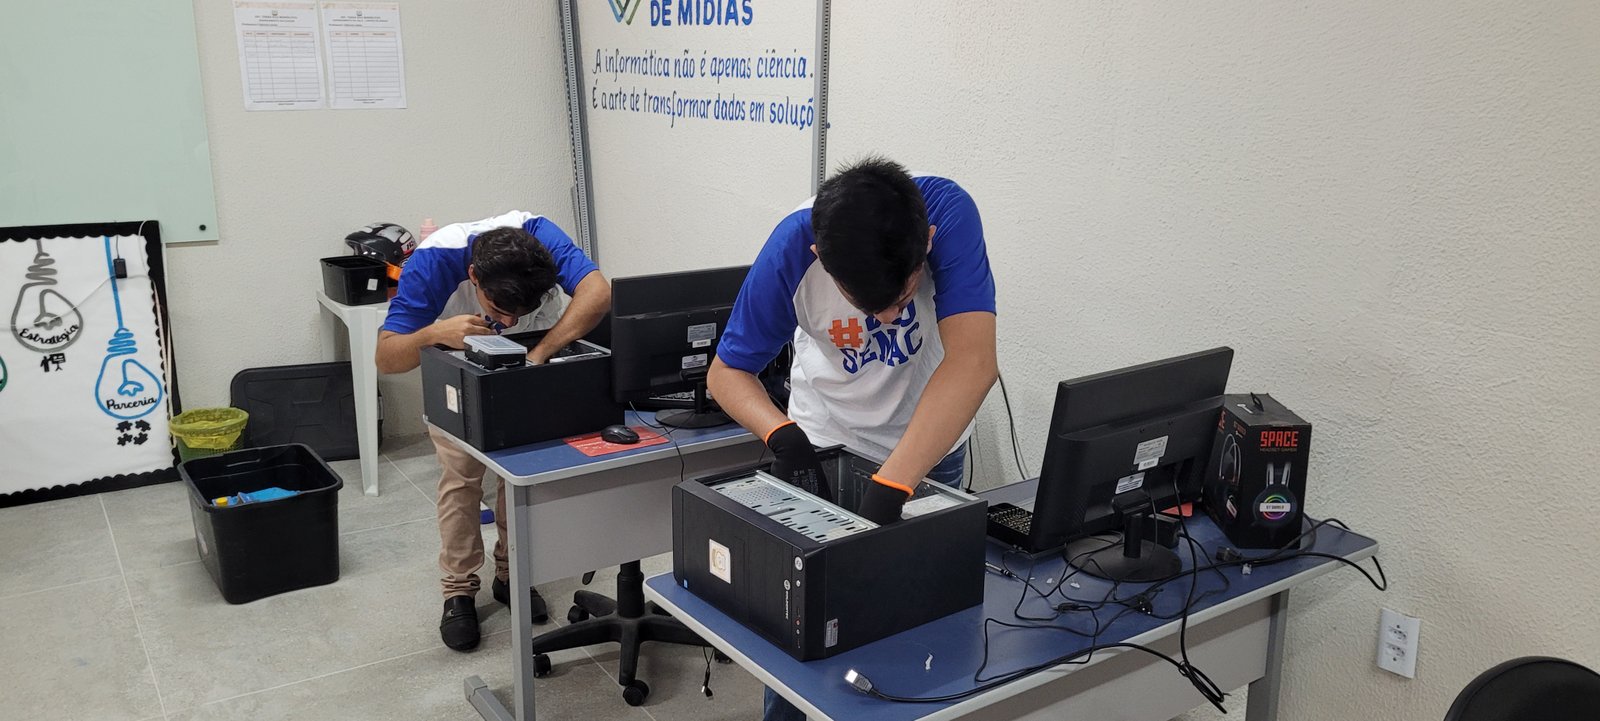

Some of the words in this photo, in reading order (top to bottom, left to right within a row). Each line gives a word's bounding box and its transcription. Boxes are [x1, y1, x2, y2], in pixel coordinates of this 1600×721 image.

[650, 0, 671, 26] DE
[592, 48, 601, 74] A
[605, 48, 670, 82] informática
[674, 48, 695, 78] não
[700, 50, 706, 77] é
[710, 57, 751, 84] apenas
[592, 78, 598, 109] É
[630, 86, 640, 112] de
[644, 88, 711, 128] transformar
[713, 93, 745, 121] dados
[750, 101, 764, 122] em
[770, 96, 814, 130] soluçõ
[839, 321, 923, 374] SENAC
[106, 397, 157, 410] Parceria
[1260, 431, 1299, 447] SPACE
